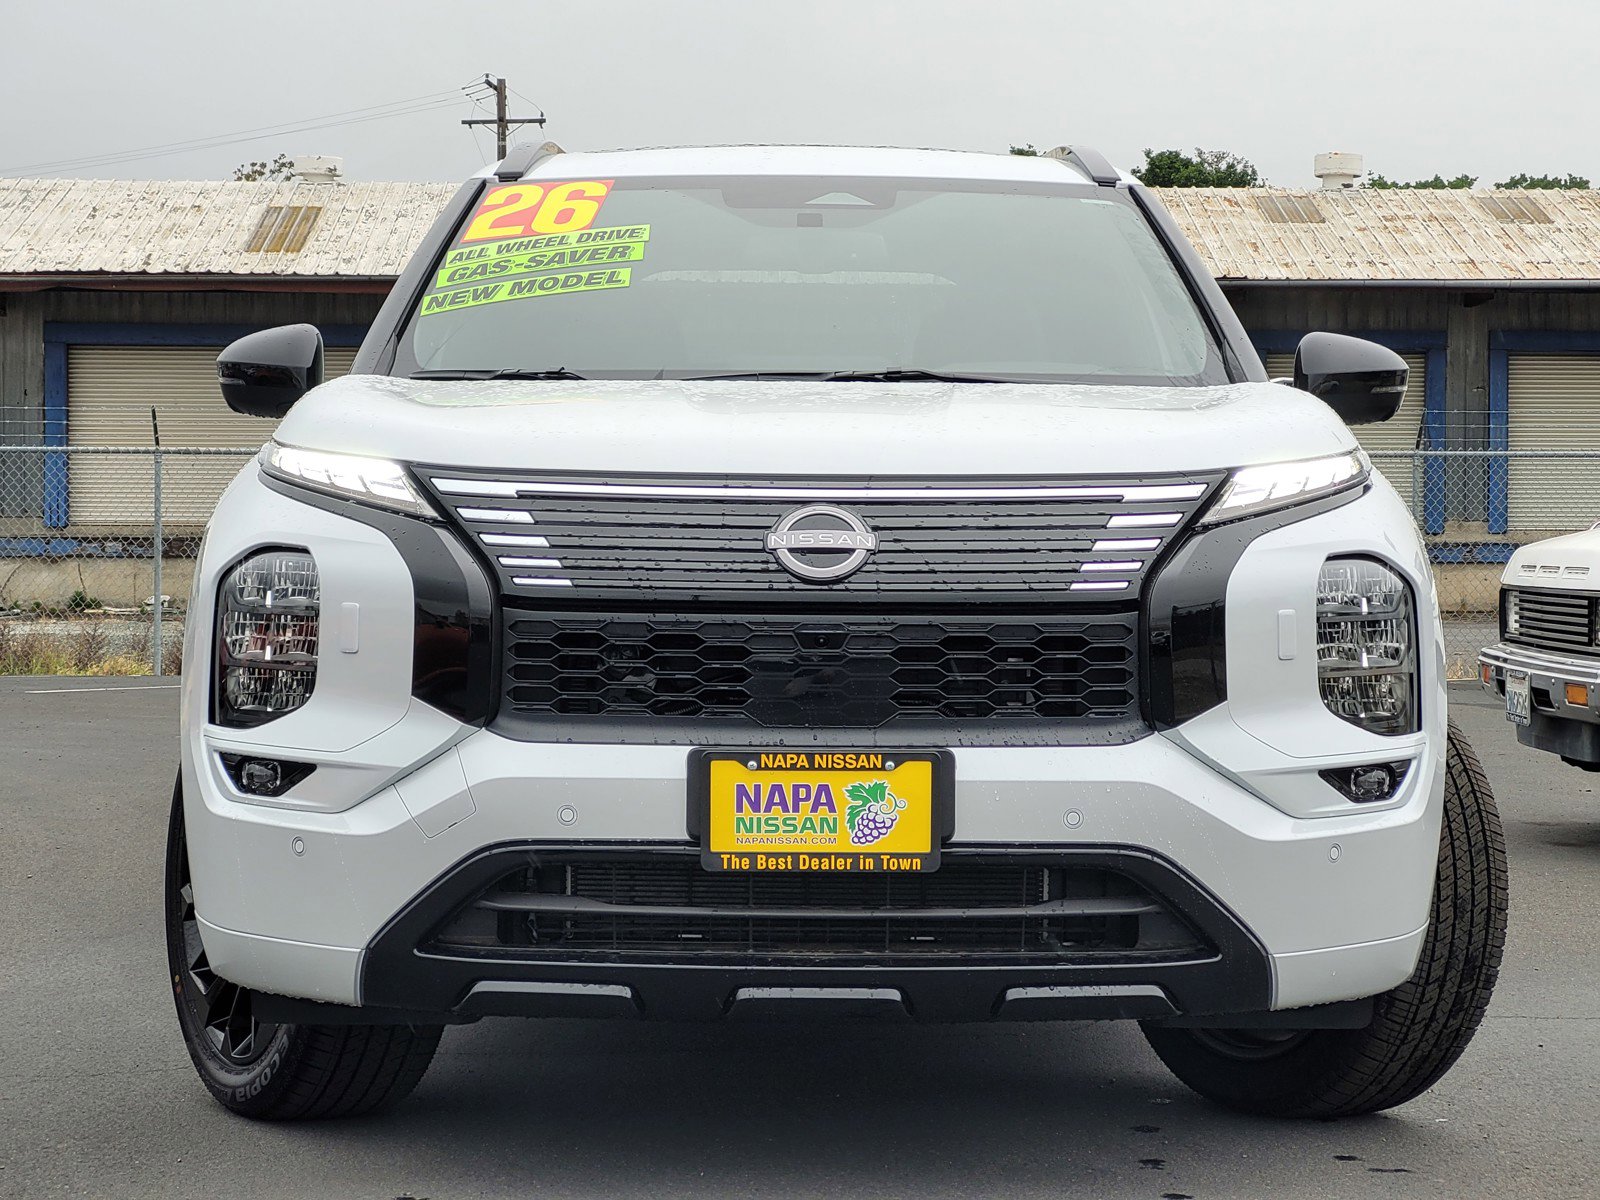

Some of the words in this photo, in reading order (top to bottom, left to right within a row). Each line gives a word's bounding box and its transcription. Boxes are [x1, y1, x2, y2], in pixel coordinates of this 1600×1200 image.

[463, 181, 608, 241] 26
[448, 247, 492, 265] ALL
[496, 236, 570, 256] WHEEL
[576, 227, 647, 245] DRIVE
[446, 245, 635, 284] GAS-SAVER
[424, 284, 504, 312] NEW
[508, 270, 623, 298] MODEL
[771, 533, 873, 547] NISSAN
[760, 753, 810, 769] NAPA
[814, 753, 883, 769] NISSAN
[735, 783, 838, 814] NAPA
[735, 816, 838, 835] NISSAN
[736, 836, 838, 845] NAPANISSAN.COM
[720, 854, 750, 870] The
[757, 854, 793, 870] Best
[799, 854, 852, 870] Dealer
[859, 854, 874, 870] in
[881, 854, 922, 870] Town
